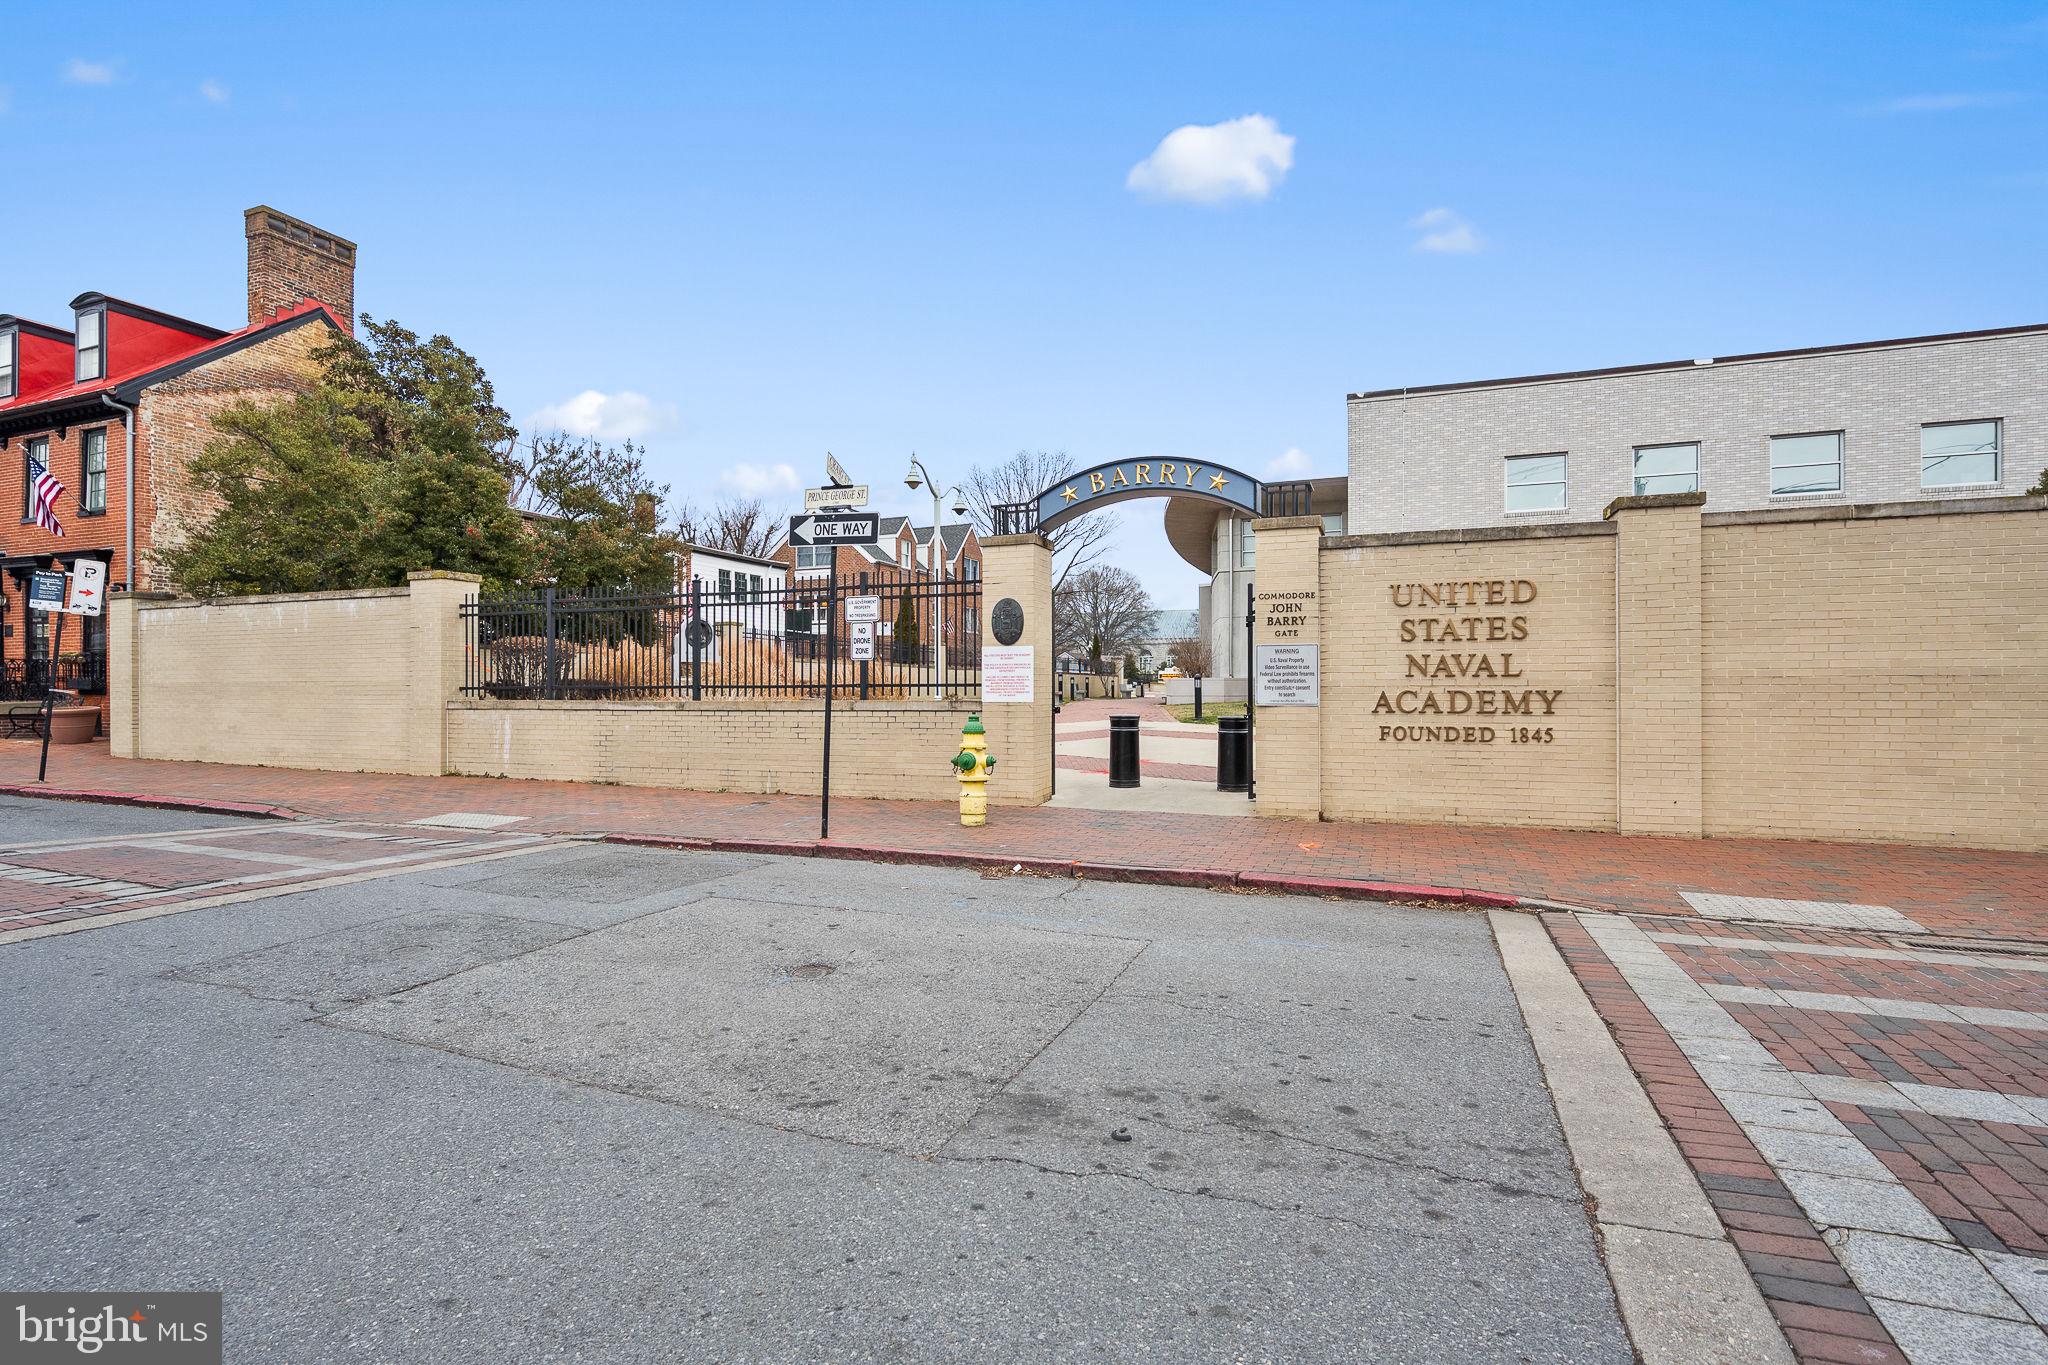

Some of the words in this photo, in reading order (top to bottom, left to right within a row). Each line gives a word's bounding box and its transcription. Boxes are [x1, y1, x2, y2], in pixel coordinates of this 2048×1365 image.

[1088, 463, 1202, 494] BARRY
[807, 491, 830, 502] PRINCE
[830, 490, 856, 501] GEORGE
[856, 489, 866, 499] ST.
[814, 523, 838, 536] ONE
[842, 522, 869, 535] WAY
[1258, 592, 1316, 600] COMMODORE
[1389, 580, 1538, 607] UNITED
[1269, 602, 1303, 613] JOHN
[1267, 615, 1307, 626] BARRY
[1274, 629, 1299, 637] GATE
[1400, 616, 1529, 642] STATES
[1405, 653, 1523, 678] NAVAL
[1371, 690, 1563, 715] ACADEMY
[1379, 725, 1496, 743] FOUNDED
[1510, 727, 1554, 743] 1845
